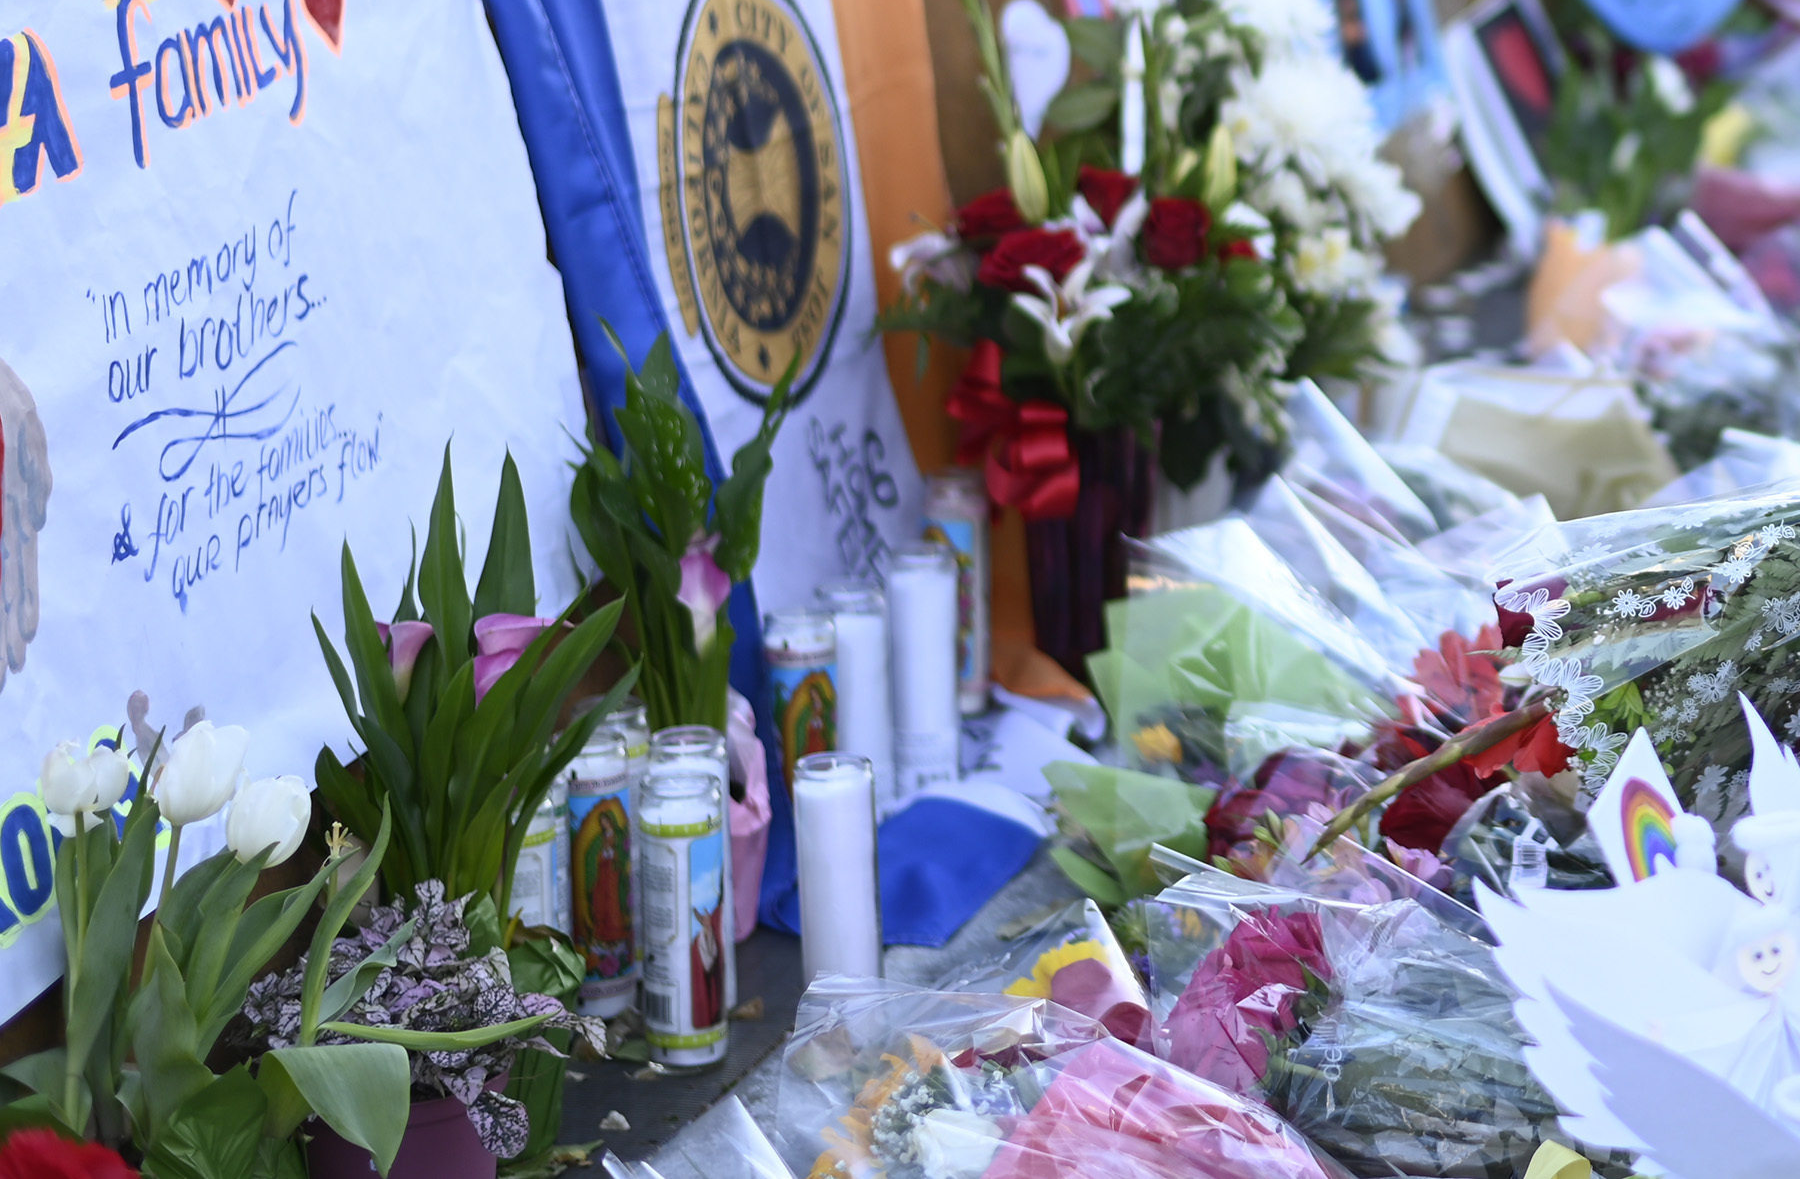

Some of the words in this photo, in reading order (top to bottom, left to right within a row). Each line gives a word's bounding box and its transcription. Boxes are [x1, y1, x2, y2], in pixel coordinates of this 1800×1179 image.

[685, 50, 743, 357] CALIFORNIA
[799, 63, 826, 122] OF
[819, 141, 839, 242] SAN
[144, 224, 257, 326] memory
[267, 189, 297, 268] of
[108, 344, 158, 403] our
[144, 485, 195, 583] for
[204, 459, 246, 519] the
[236, 464, 328, 574] prayers
